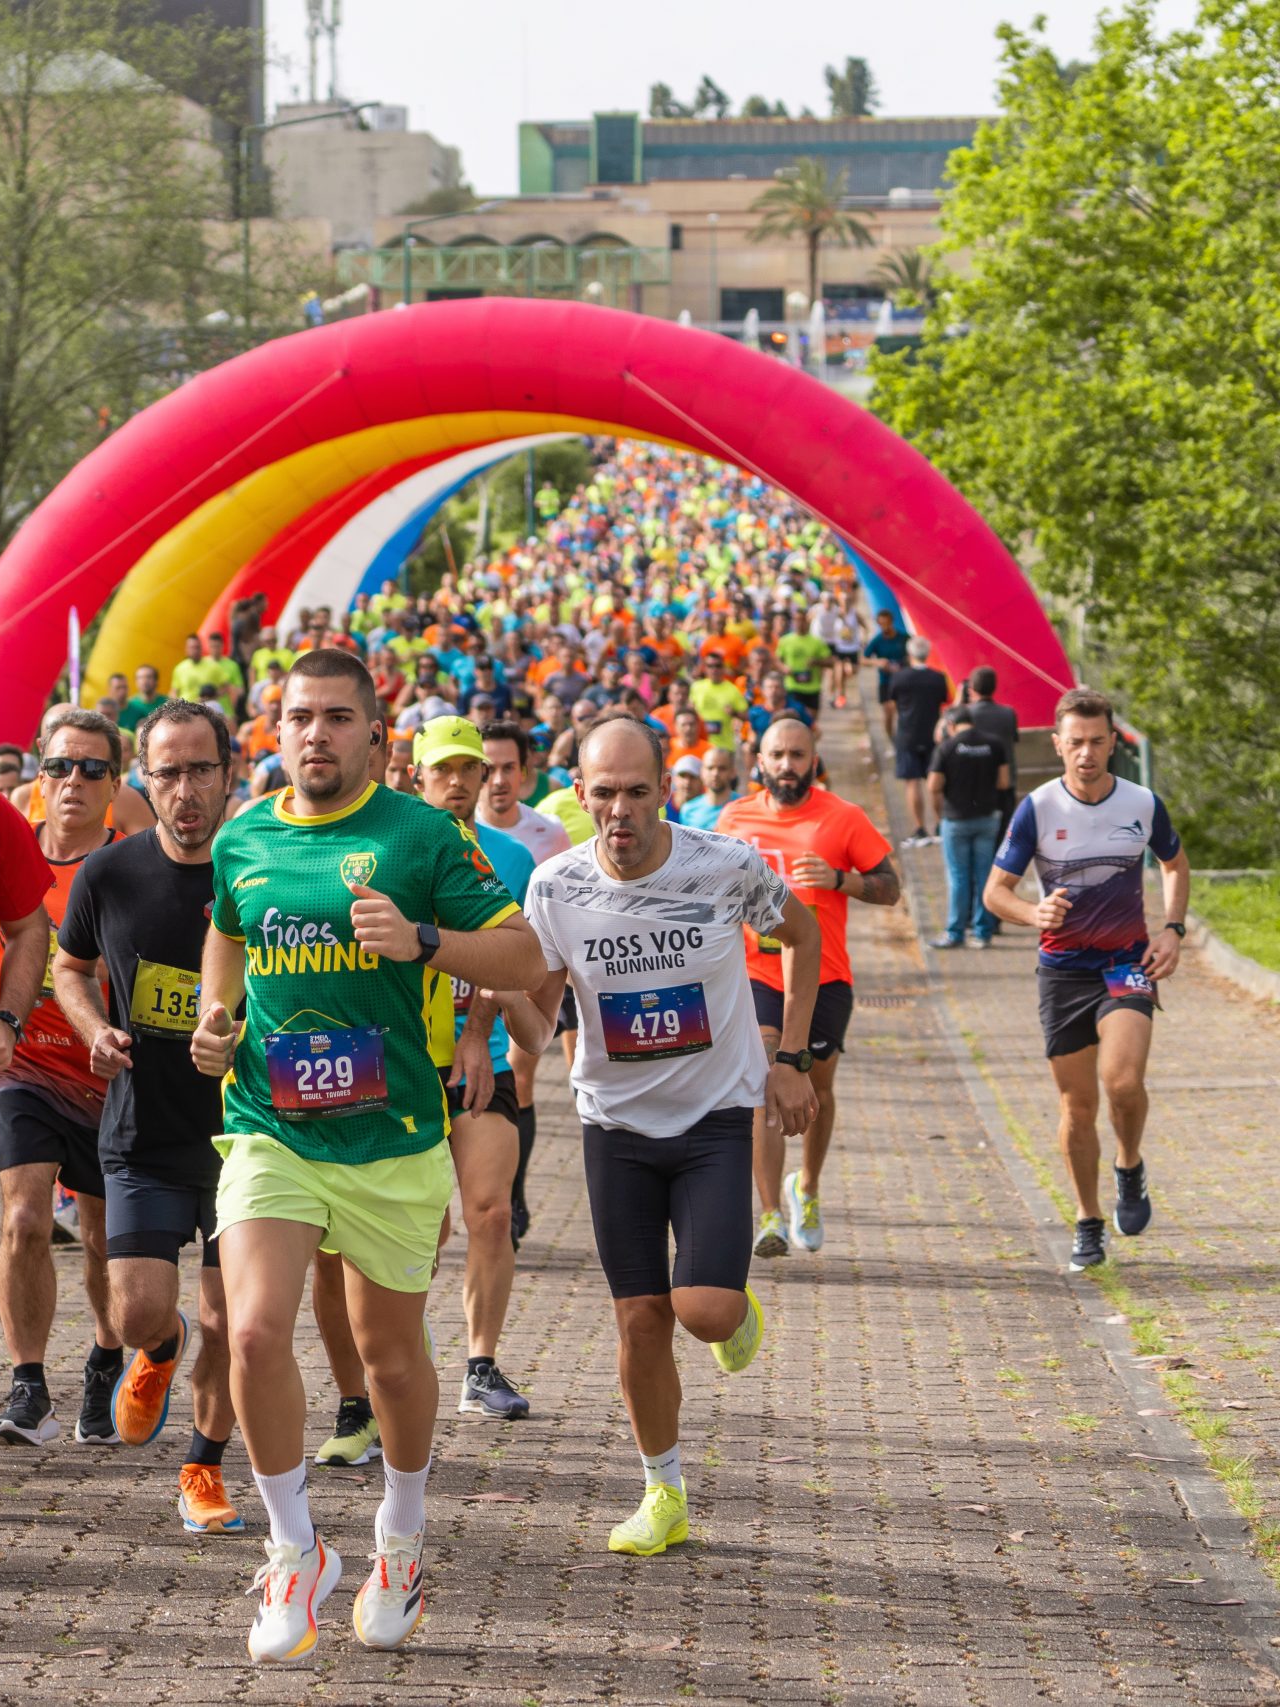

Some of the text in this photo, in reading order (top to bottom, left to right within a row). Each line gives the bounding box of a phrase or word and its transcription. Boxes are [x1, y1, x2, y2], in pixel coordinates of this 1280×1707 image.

[257, 907, 339, 950] fiães
[584, 926, 703, 962] ZOSS VOG
[247, 942, 379, 976] RUNNING
[605, 953, 685, 977] RUNNING
[630, 1009, 681, 1038] 479
[295, 1056, 354, 1091] 229
